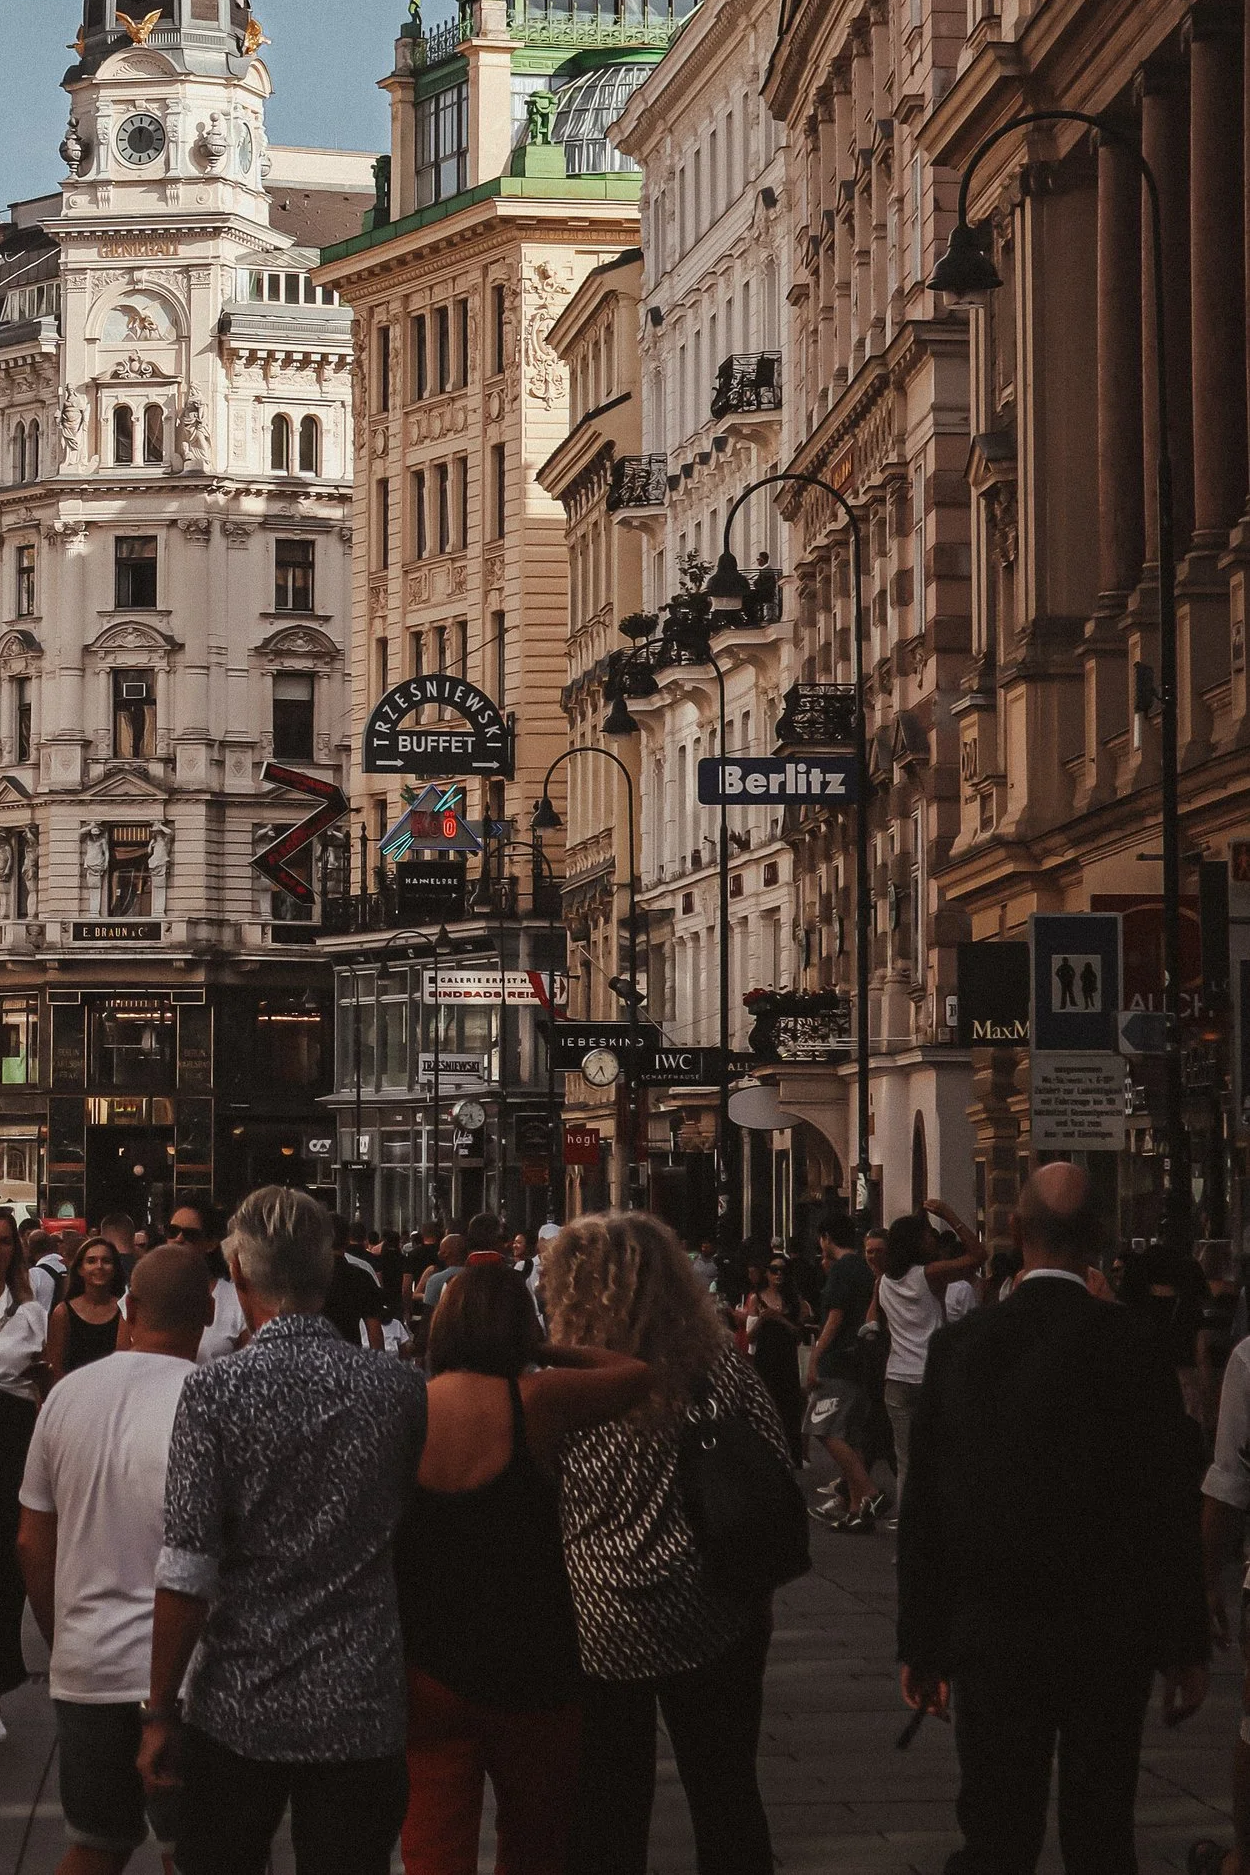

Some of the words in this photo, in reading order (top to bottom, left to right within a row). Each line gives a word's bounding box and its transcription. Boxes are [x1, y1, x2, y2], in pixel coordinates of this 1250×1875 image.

[398, 735, 476, 753] BUFFET
[718, 763, 846, 795] Berlitz
[94, 927, 129, 938] BRAUN
[654, 1053, 693, 1070] IWC
[567, 1133, 596, 1147] högl
